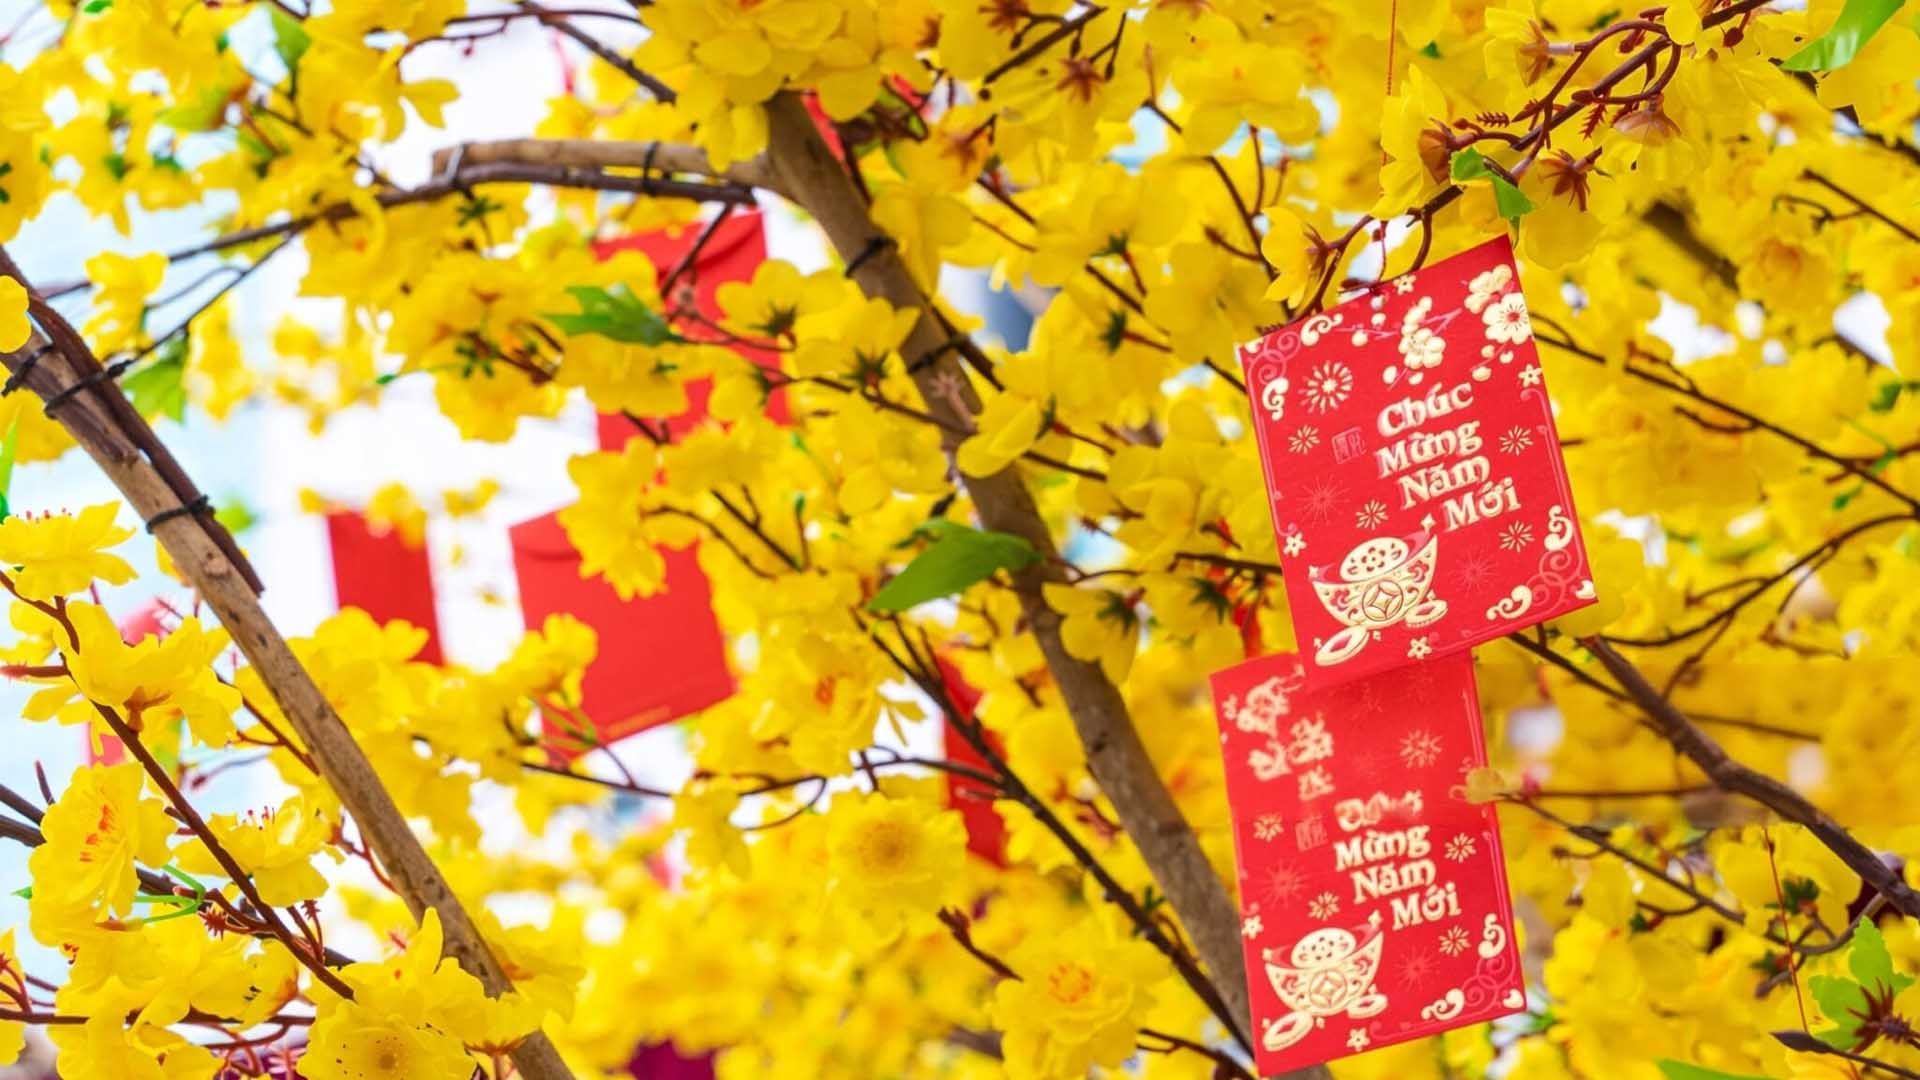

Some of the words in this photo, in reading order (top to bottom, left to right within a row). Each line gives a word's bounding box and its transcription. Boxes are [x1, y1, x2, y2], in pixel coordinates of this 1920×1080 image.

[1377, 382, 1473, 437] Chúc
[1375, 420, 1483, 479] Mừng
[1397, 456, 1490, 510] Năm
[1443, 477, 1521, 532] Mới
[1333, 825, 1431, 872] Mừng
[1350, 859, 1436, 904] Năm
[1390, 881, 1461, 931] Mới
